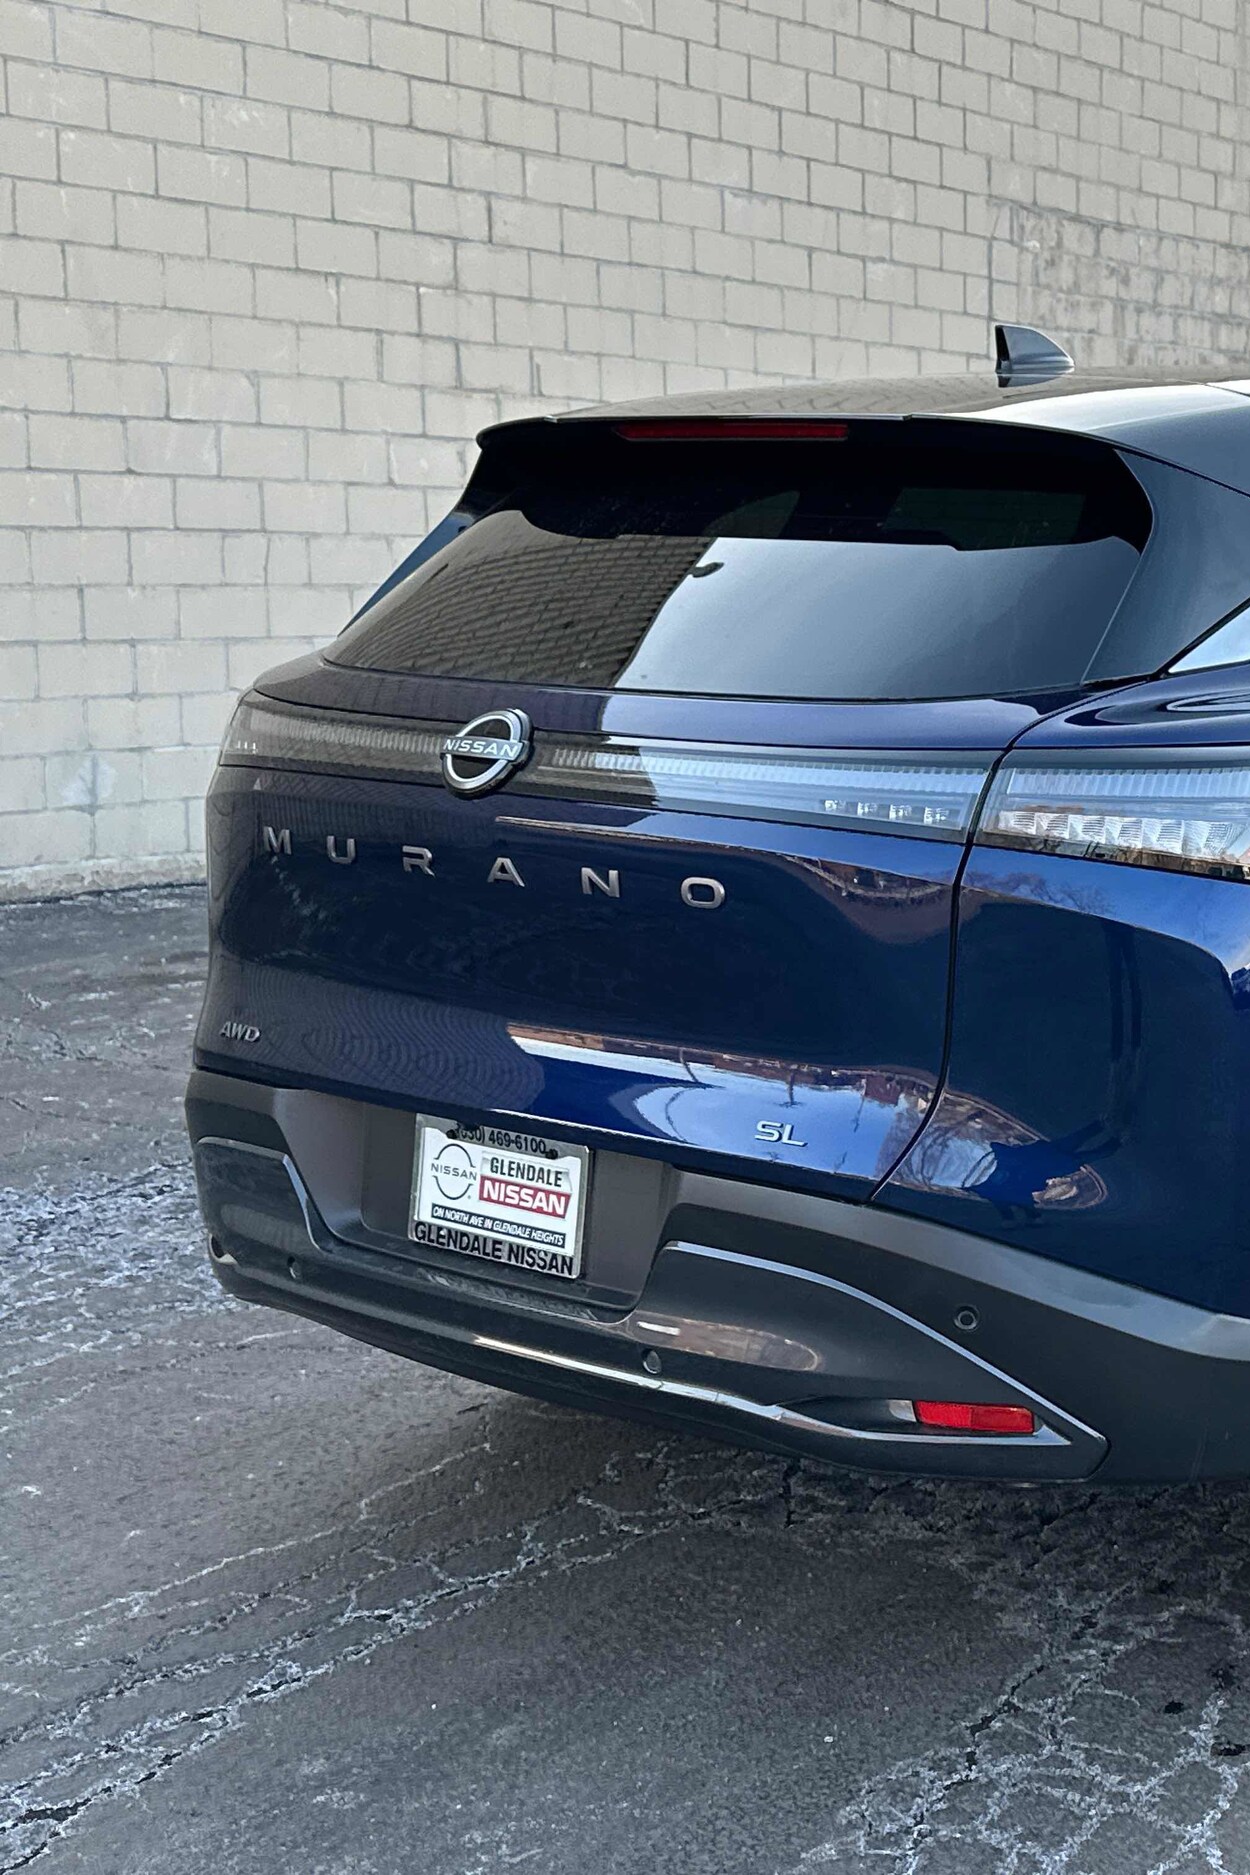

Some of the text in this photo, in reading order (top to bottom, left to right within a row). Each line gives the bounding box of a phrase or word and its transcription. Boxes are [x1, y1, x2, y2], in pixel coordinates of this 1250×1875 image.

[442, 738, 519, 758] NISSAN
[262, 825, 726, 910] MURANO
[219, 1020, 261, 1042] AWD
[488, 1129, 547, 1154] 469-6100
[754, 1120, 809, 1147] SL
[430, 1162, 478, 1181] NISSAN
[489, 1156, 563, 1188] GLENDALE
[482, 1178, 566, 1215] NISSAN
[433, 1206, 564, 1246] ON NORTH AVE IN GLENDALE HEIGHTS
[414, 1221, 574, 1276] GLENDALE NISSAN
